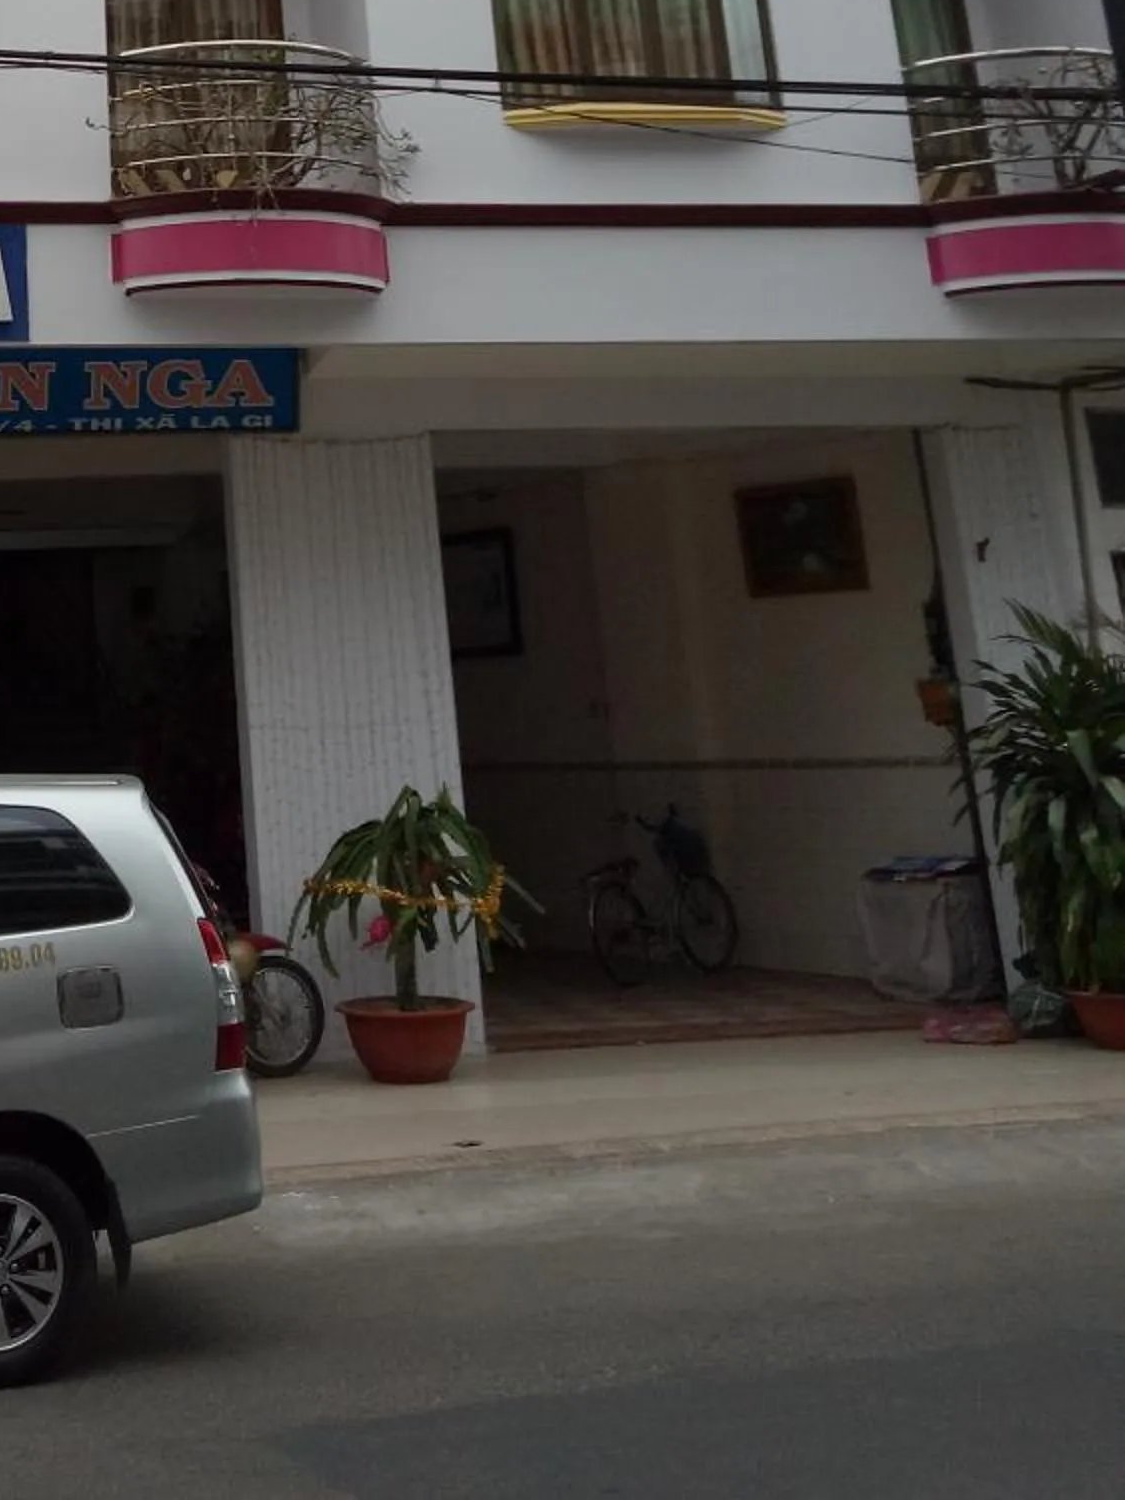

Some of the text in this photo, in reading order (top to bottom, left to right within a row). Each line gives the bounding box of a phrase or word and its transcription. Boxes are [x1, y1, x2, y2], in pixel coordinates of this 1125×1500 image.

[83, 360, 274, 410] NGA
[191, 416, 231, 430] LA
[241, 414, 273, 429] GI
